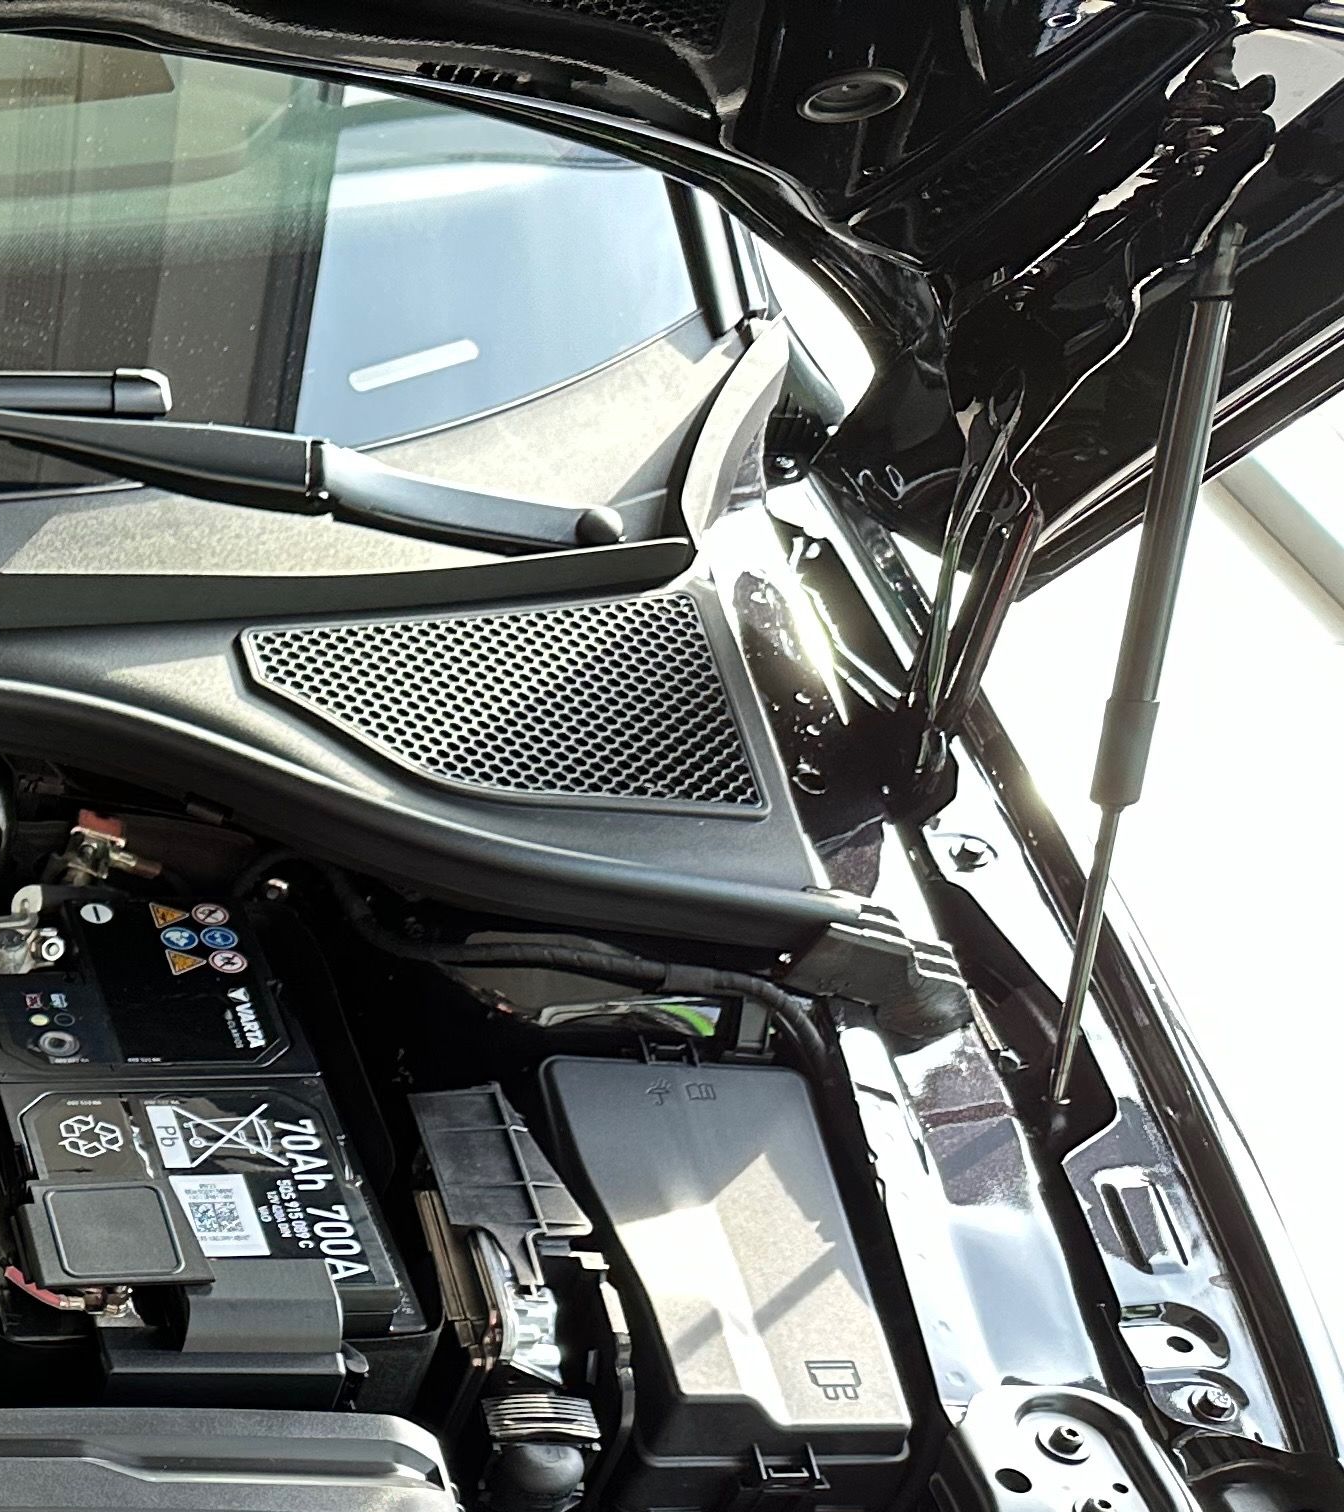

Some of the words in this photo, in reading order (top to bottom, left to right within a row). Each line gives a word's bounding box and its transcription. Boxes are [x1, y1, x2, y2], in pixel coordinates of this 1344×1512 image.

[235, 1001, 266, 1048] VARTA
[157, 1125, 177, 1147] Pb
[274, 1119, 334, 1191] 70Ah
[306, 1204, 370, 1281] 700A
[284, 1201, 304, 1220] 915
